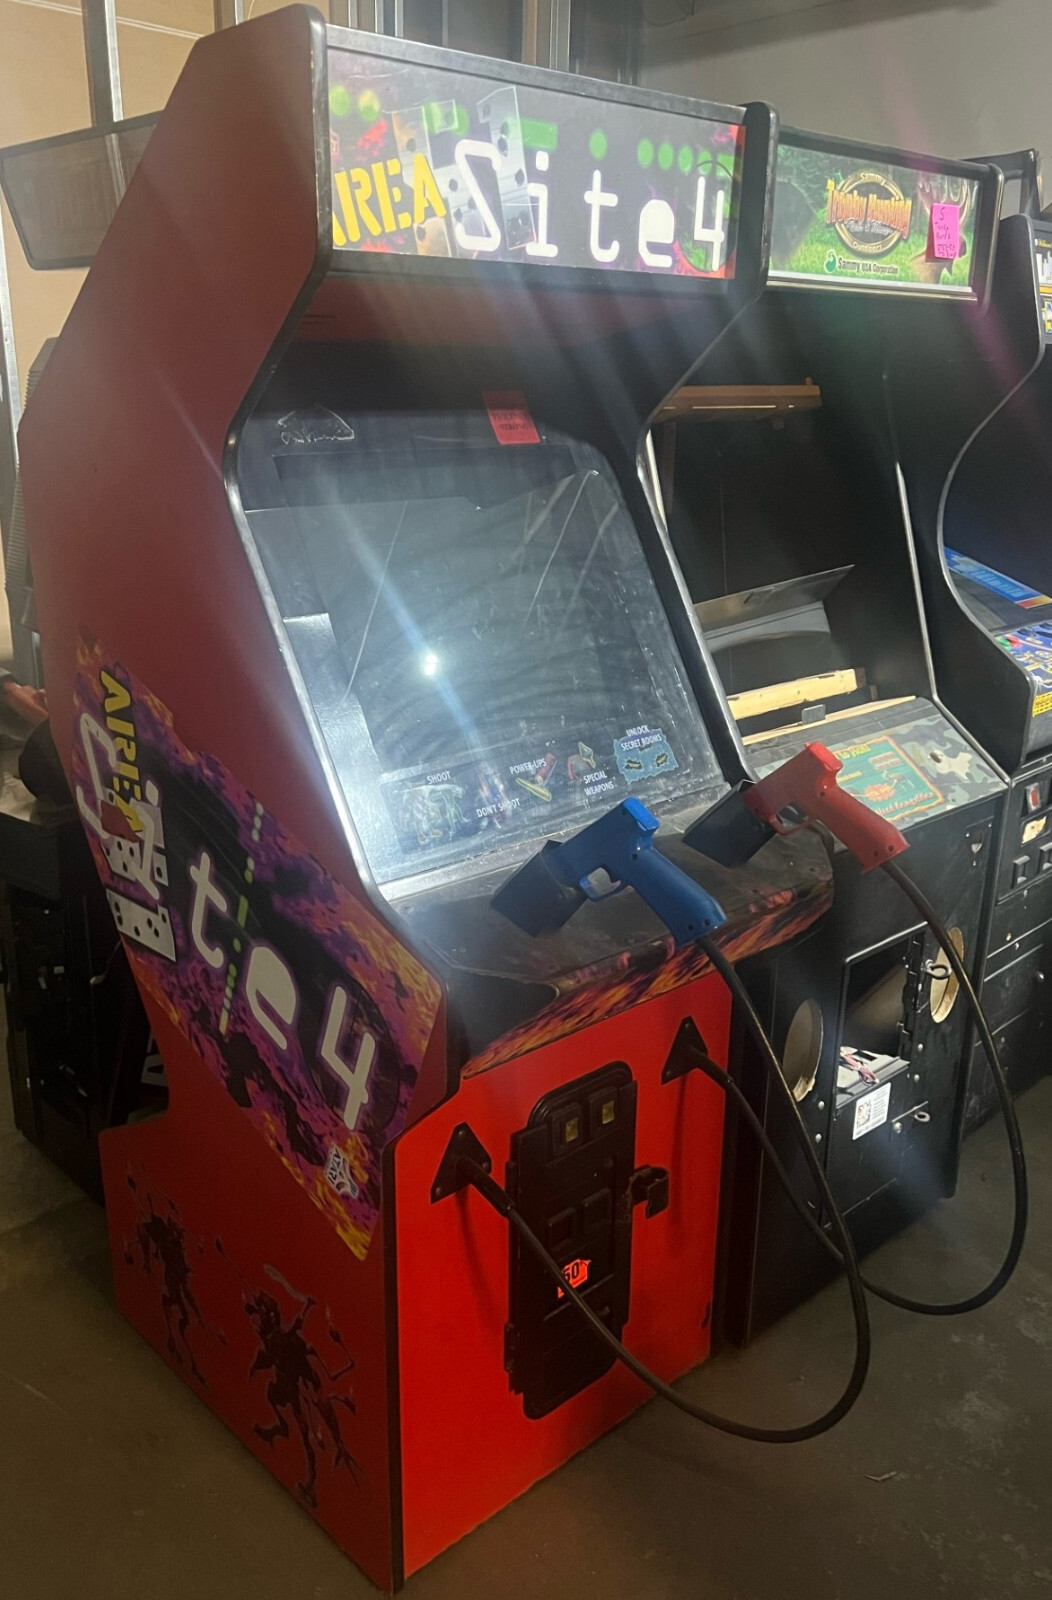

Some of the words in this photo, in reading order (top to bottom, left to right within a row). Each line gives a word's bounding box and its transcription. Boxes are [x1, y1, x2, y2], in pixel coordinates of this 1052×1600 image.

[332, 152, 447, 247] REA
[837, 257, 861, 273] Sammy
[625, 725, 650, 738] UNLOCK
[620, 738, 641, 752] SECRET
[641, 733, 663, 747] ROOMS
[509, 757, 547, 775] POWER-UPS
[426, 771, 452, 785] SHOOT
[583, 770, 607, 784] SPECIAL
[584, 781, 614, 796] WEAPONS
[476, 803, 498, 818] DON'T
[498, 798, 521, 812] SHOOT
[327, 1146, 342, 1185] ATARI
